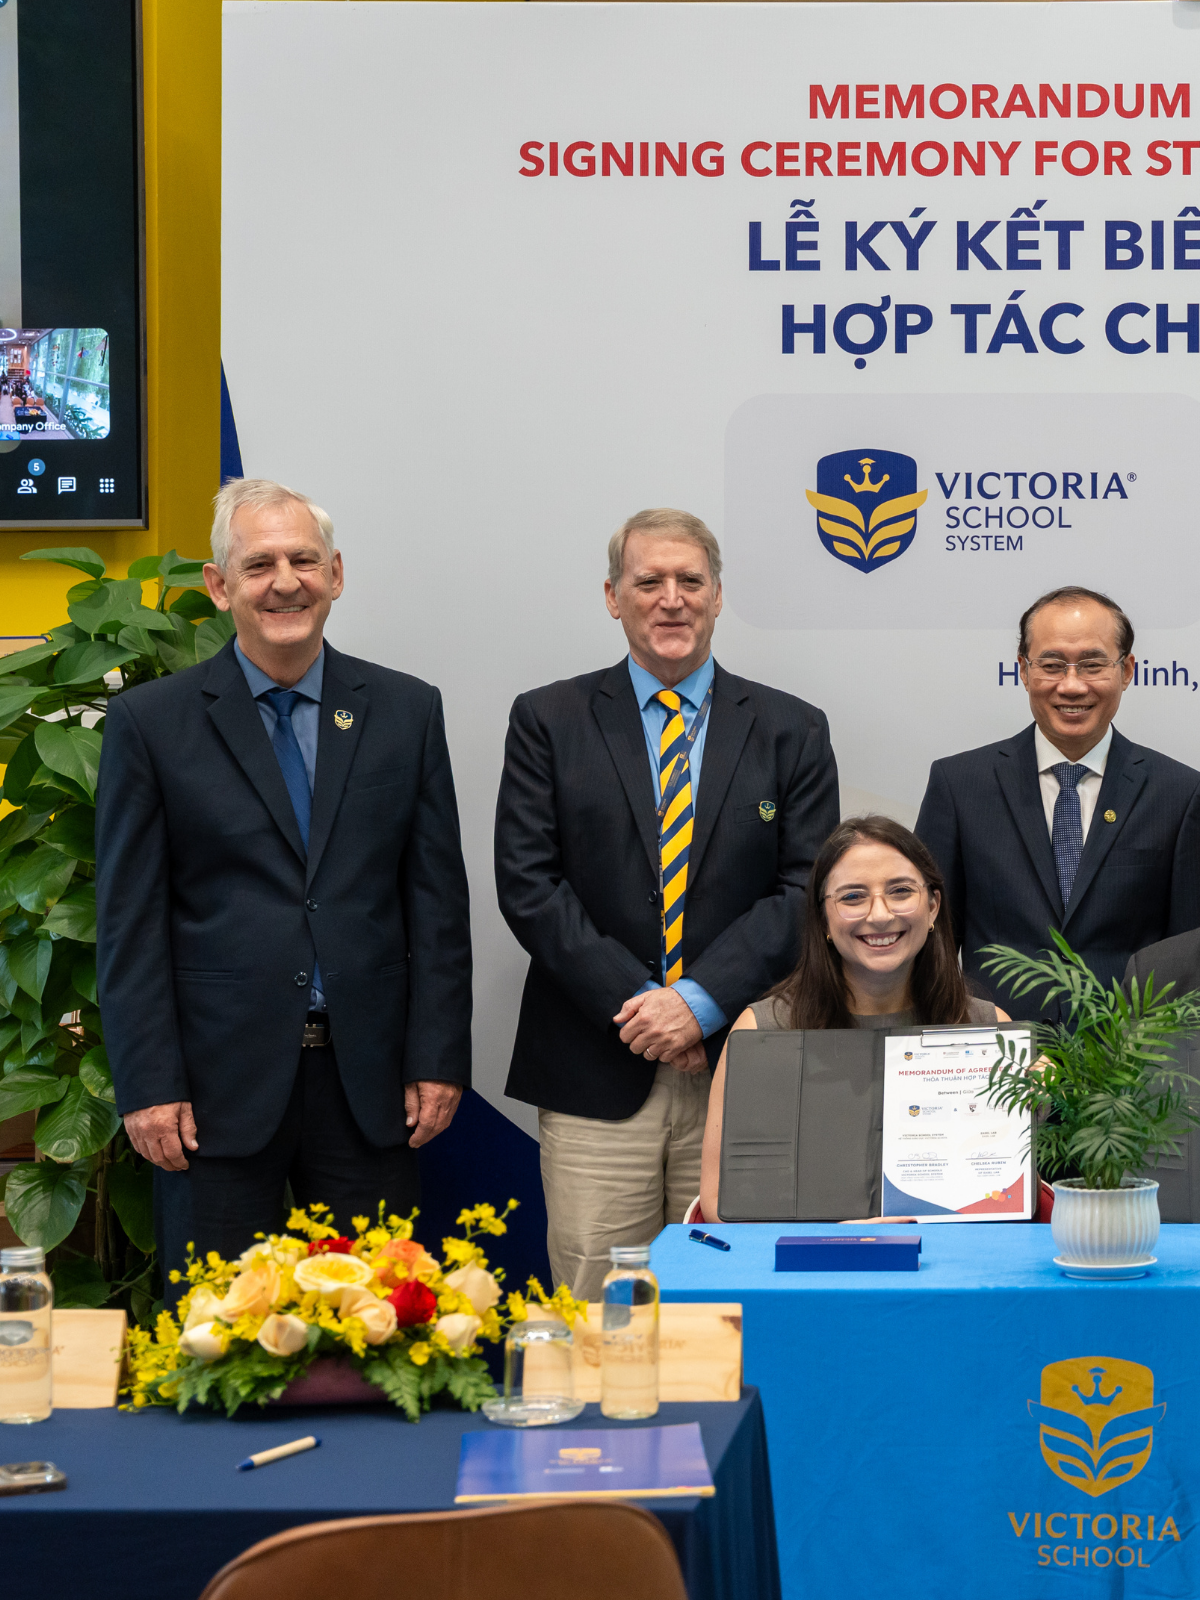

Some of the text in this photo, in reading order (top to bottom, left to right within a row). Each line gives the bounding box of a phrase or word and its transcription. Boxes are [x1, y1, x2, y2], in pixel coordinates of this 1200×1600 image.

[809, 82, 1191, 120] MEMORANDUM
[518, 140, 725, 178] SIGNING
[740, 140, 1022, 178] CEREMONY
[1034, 139, 1133, 177] FOR
[748, 198, 821, 272] LỄ
[844, 206, 938, 272] KÝ
[956, 199, 1085, 271] KẾT
[781, 294, 934, 370] HỢP
[950, 289, 1086, 355] TÁC
[0, 421, 66, 433] mpany Office
[33, 462, 40, 472] 5
[945, 505, 1072, 530] SCHOOL
[945, 534, 1023, 552] SYSTEM
[997, 661, 1019, 688] H
[1133, 658, 1200, 693] inh,
[1007, 1512, 1182, 1542] VICTORIA
[1037, 1544, 1150, 1568] SCHOOL
